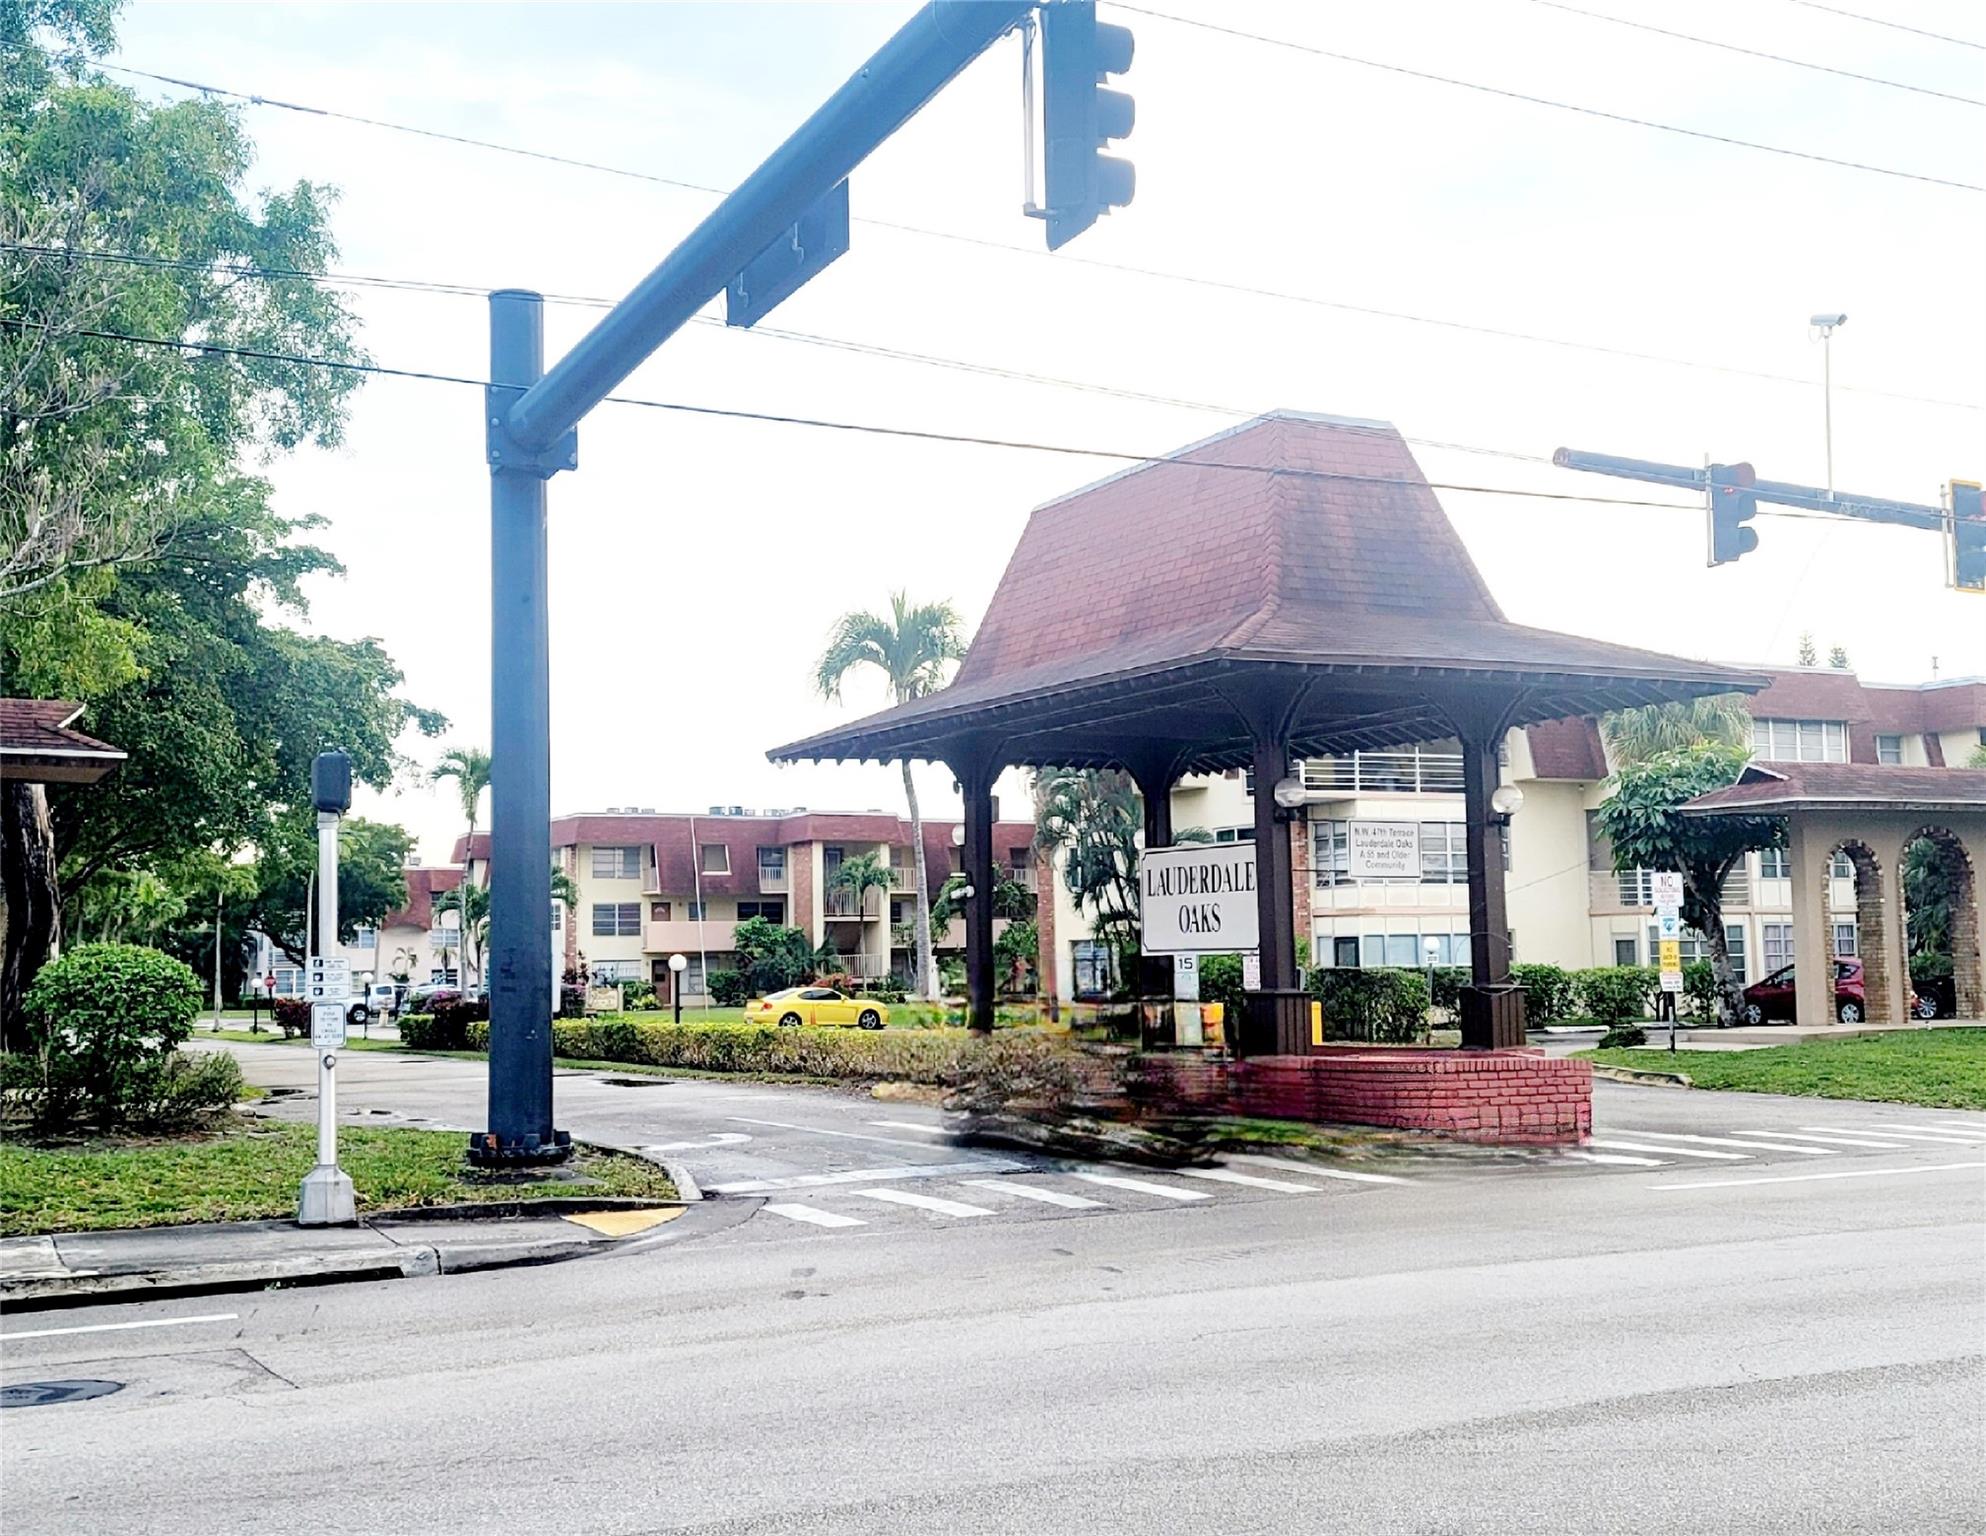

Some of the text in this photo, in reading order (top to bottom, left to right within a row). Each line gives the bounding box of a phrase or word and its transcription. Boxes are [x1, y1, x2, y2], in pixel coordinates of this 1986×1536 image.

[1356, 839, 1414, 848] Lauderdale Oaks
[1377, 850, 1390, 859] and
[1391, 850, 1411, 859] Older
[1365, 860, 1406, 871] Community
[1147, 861, 1255, 897] LAUDERDALE
[1660, 875, 1674, 887] NO
[1178, 902, 1221, 934] OAKS
[1178, 957, 1193, 970] 15
